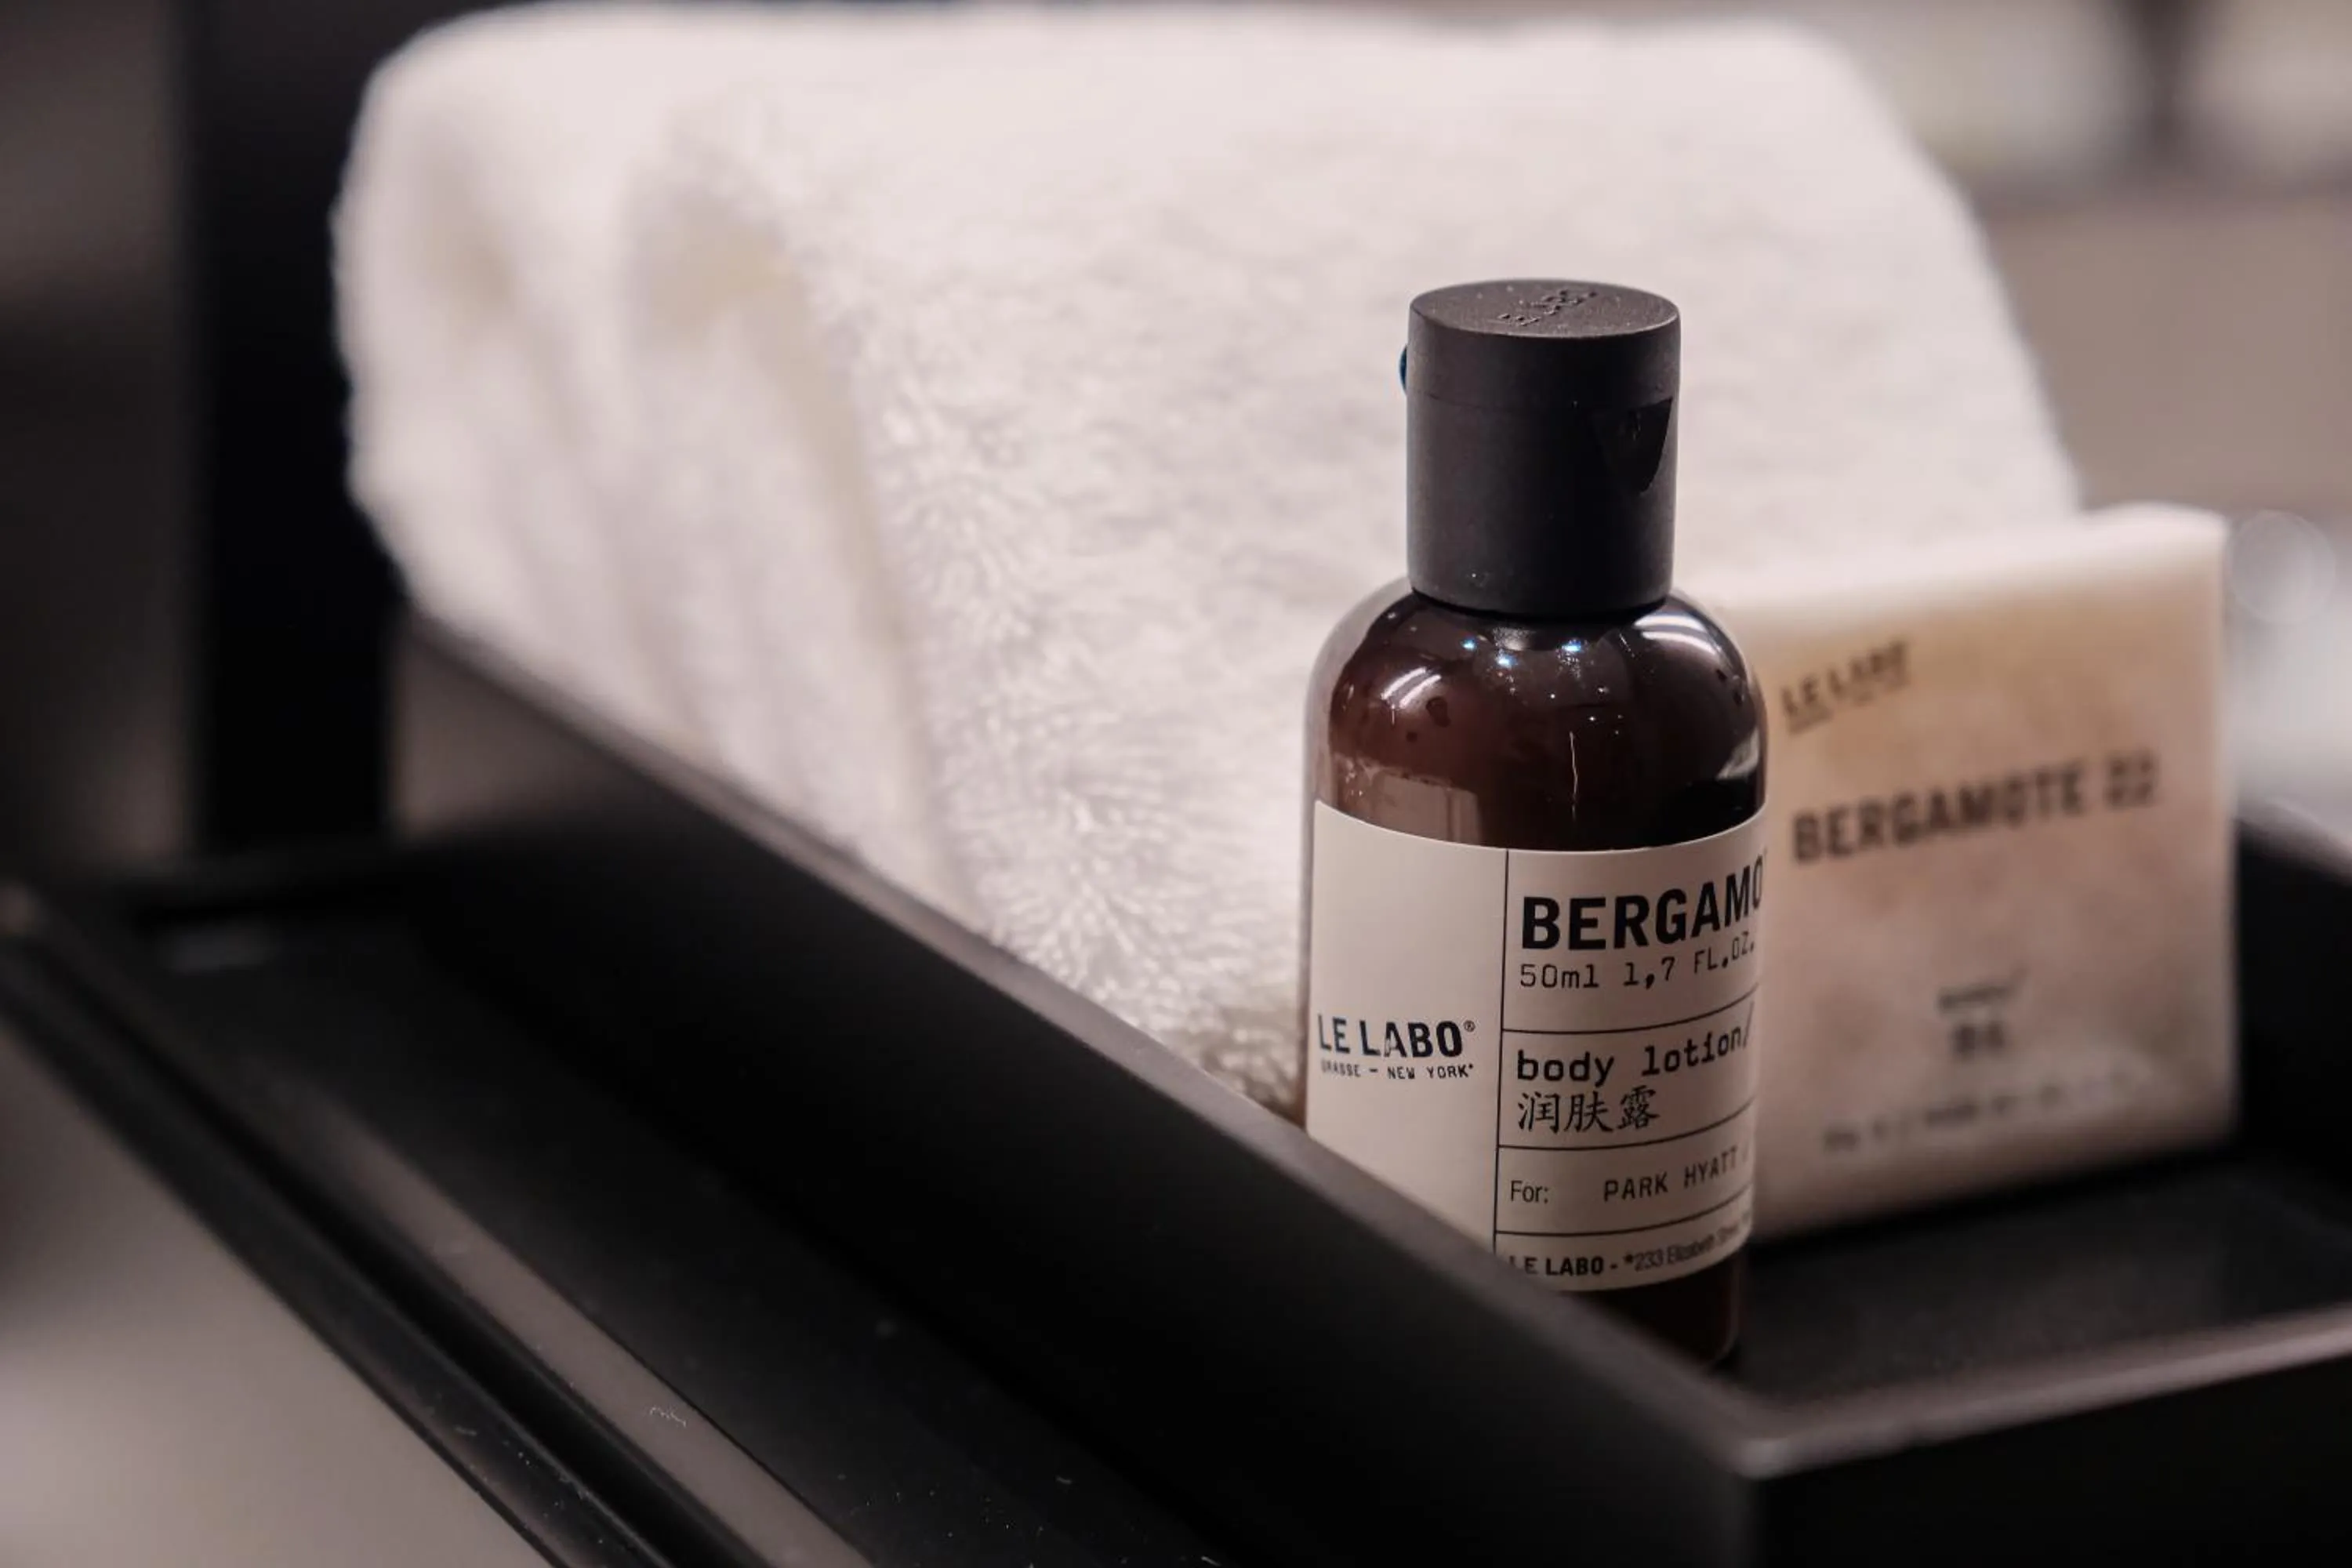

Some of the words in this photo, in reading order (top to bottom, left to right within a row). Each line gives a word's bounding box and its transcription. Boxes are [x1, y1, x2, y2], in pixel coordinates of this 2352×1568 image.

[1791, 755, 2087, 867] BERGAMOTE
[1520, 851, 1767, 951] BERGAMO
[1519, 963, 1599, 989] 50ml
[1622, 956, 1676, 990] 1,7
[1317, 1013, 1351, 1054] LE
[1516, 1050, 1614, 1087] body
[1641, 1000, 1754, 1076] lotion/
[1387, 1065, 1416, 1080] NEW
[1517, 1085, 1661, 1134] 润肤露
[1509, 1180, 1549, 1204] For:
[1603, 1171, 1668, 1202] PARK
[1683, 1145, 1737, 1190] HYATT
[1545, 1256, 1604, 1276] LABO
